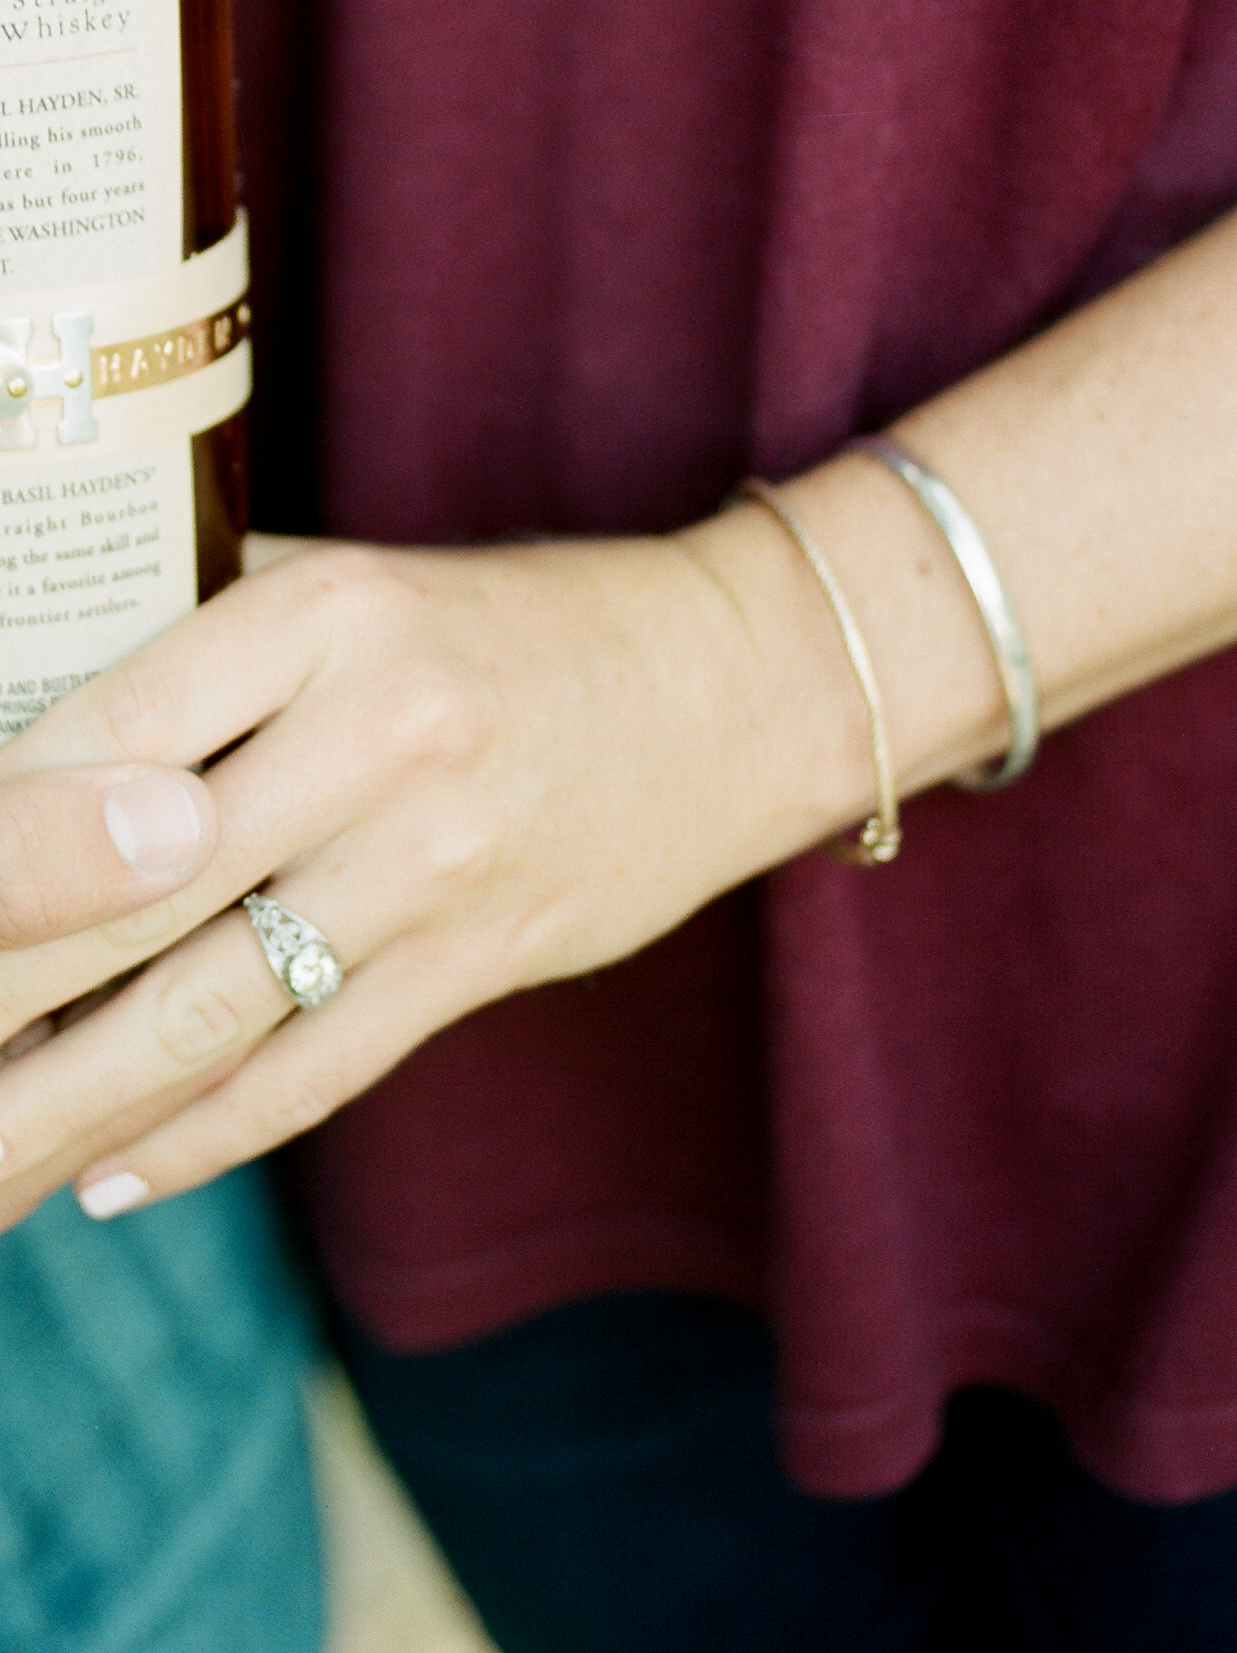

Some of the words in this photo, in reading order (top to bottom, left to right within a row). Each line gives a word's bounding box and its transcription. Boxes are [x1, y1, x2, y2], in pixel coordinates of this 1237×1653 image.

[0, 8, 132, 43] Whiskey
[47, 125, 73, 144] his
[80, 113, 143, 139] smooth
[53, 158, 73, 176] in
[22, 192, 53, 210] but
[61, 186, 98, 205] four
[104, 179, 146, 201] years
[9, 206, 146, 243] WASHINGTON
[1, 484, 55, 505] BASIL
[80, 501, 159, 527] Bourbon
[22, 547, 50, 565] the
[55, 545, 95, 562] same
[100, 531, 130, 555] skill
[135, 525, 160, 546] and
[7, 580, 21, 597] it
[26, 584, 36, 596] a
[42, 572, 106, 594] favorite
[0, 608, 70, 630] frontier
[7, 679, 37, 696] AND
